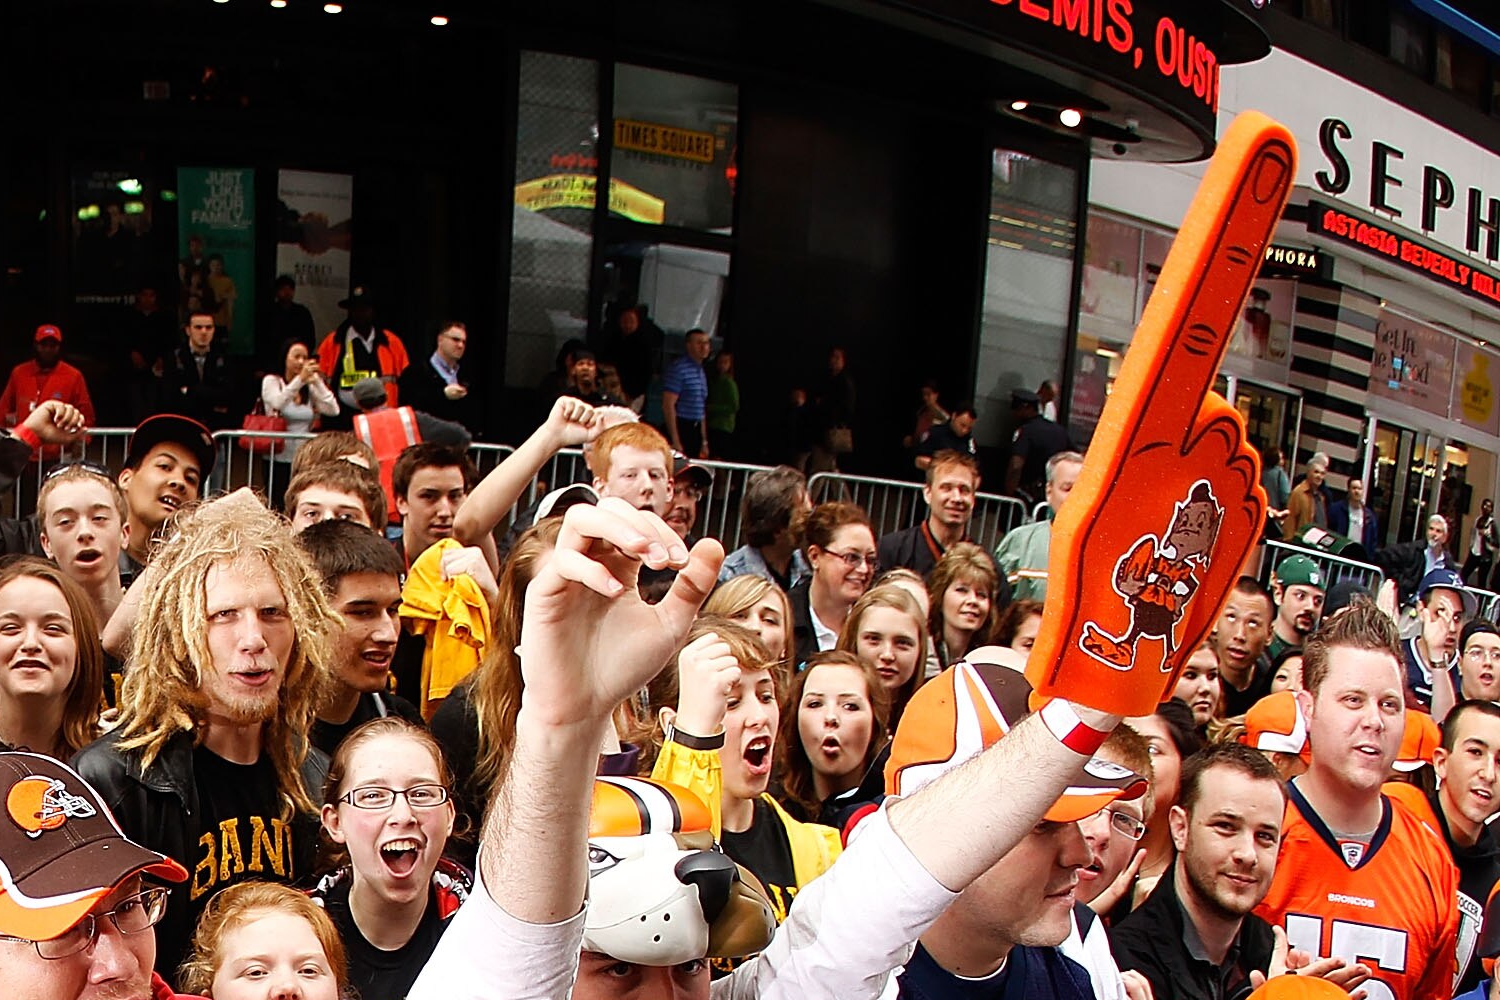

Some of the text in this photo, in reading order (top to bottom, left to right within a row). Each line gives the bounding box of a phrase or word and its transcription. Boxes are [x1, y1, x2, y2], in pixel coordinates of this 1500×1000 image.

[617, 123, 710, 157] TIMES SQUARE
[205, 170, 243, 185] JUST
[211, 184, 244, 198] LIKE
[1315, 118, 1500, 262] SEPH
[202, 197, 244, 211] YOUR
[190, 815, 294, 902] BAN
[1327, 893, 1376, 908] BRONCOS
